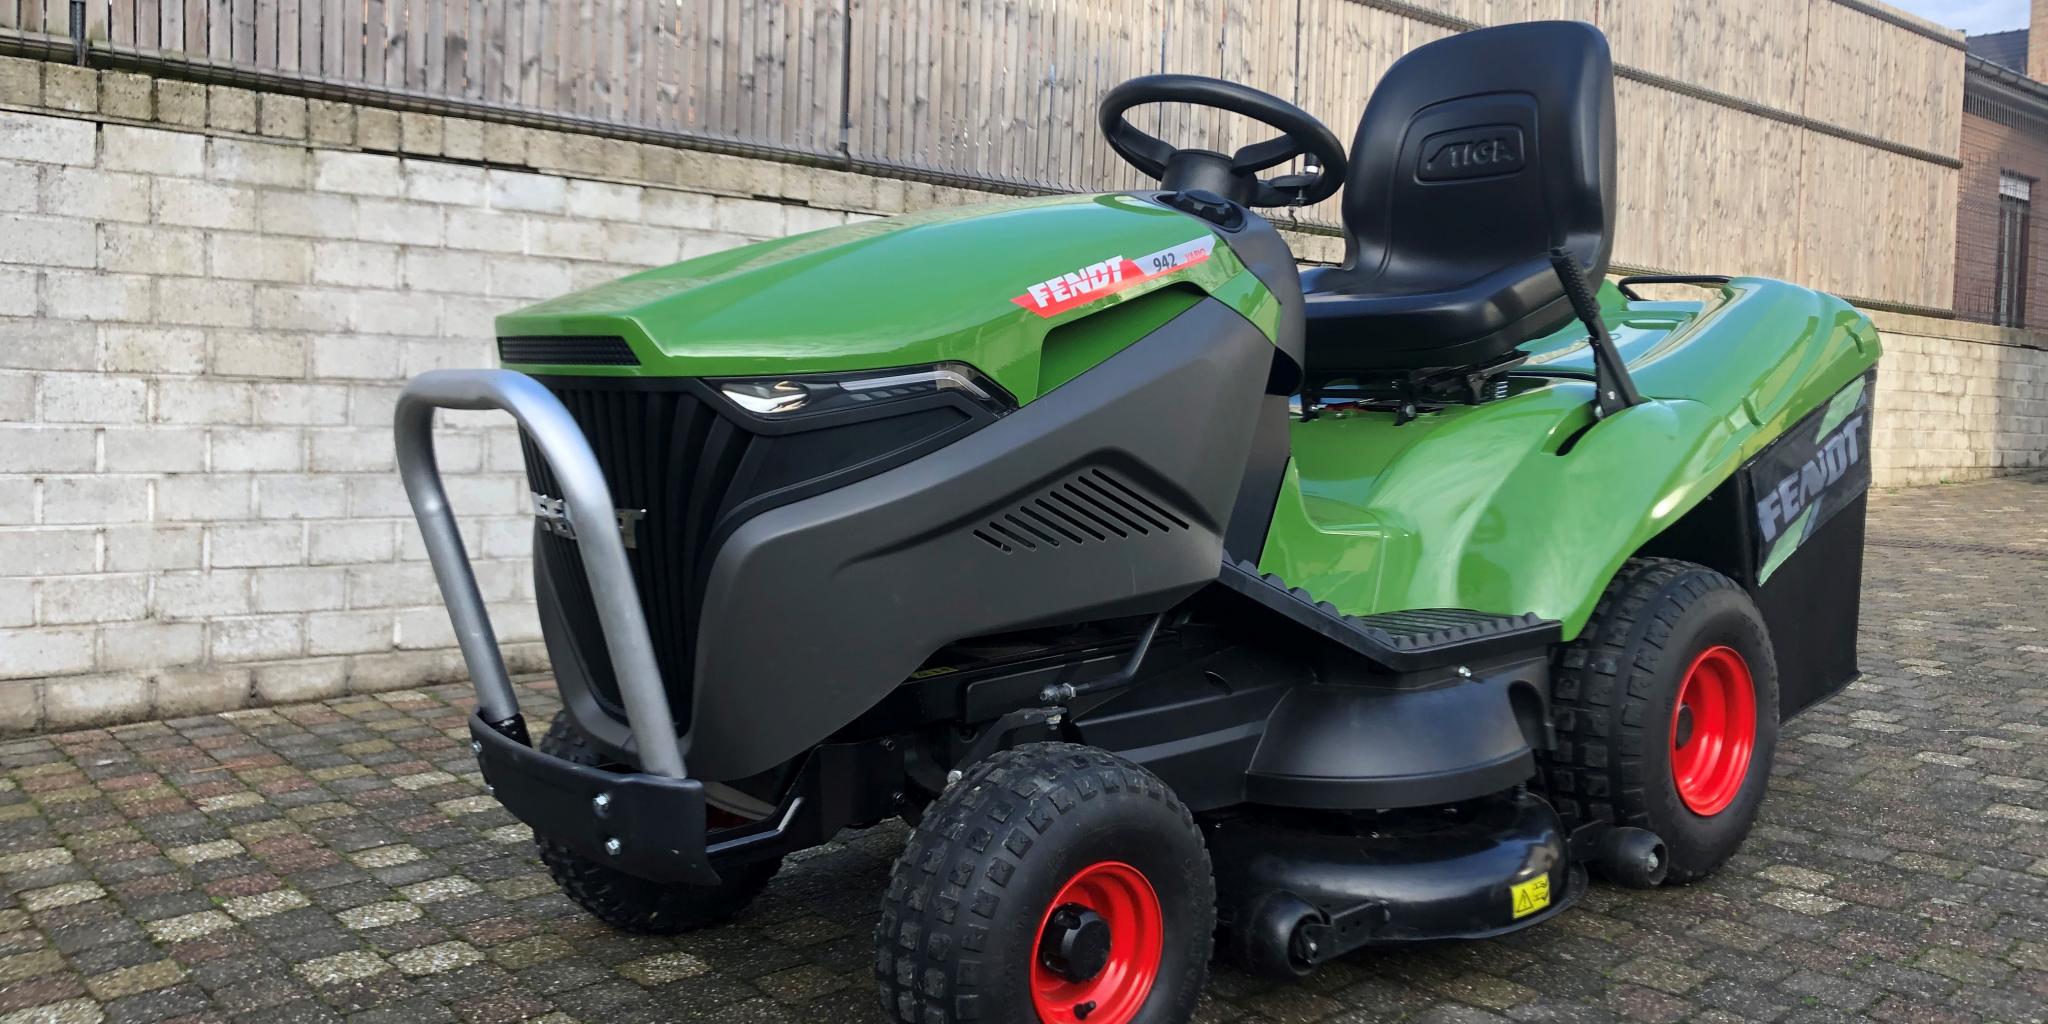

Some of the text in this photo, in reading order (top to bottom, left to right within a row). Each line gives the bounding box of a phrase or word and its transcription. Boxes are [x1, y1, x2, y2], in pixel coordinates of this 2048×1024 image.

[1026, 255, 1124, 309] FENDT
[1153, 252, 1178, 272] 942
[1757, 414, 1864, 543] FENDT
